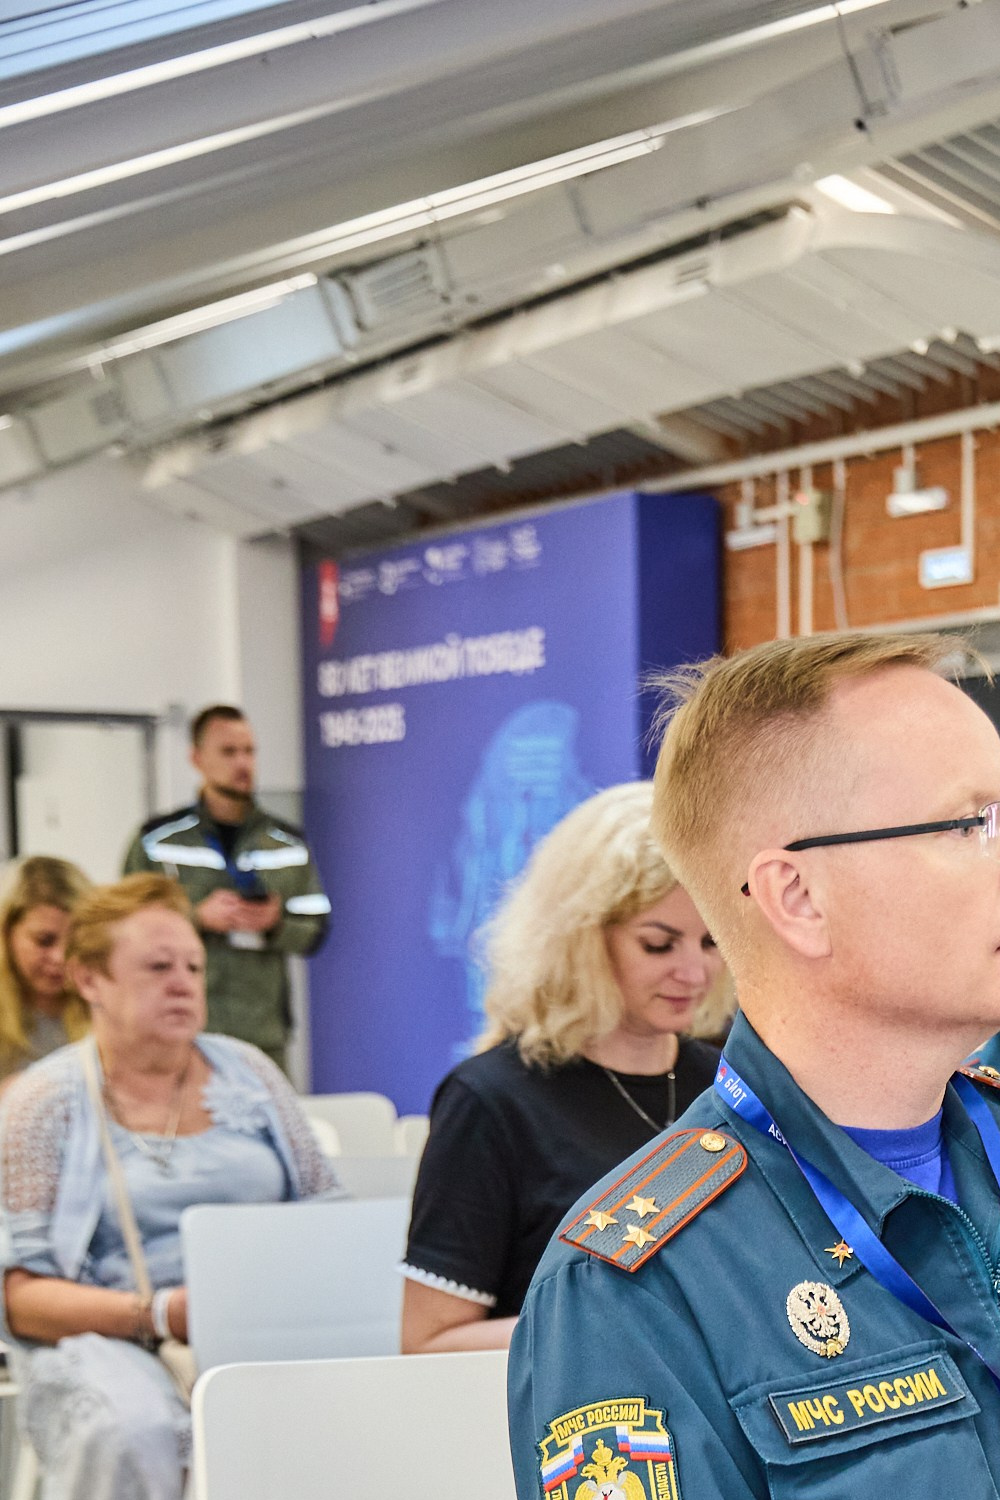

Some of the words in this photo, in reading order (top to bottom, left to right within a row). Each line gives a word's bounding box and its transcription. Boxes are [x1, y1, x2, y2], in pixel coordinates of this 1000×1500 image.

[557, 1415, 586, 1440] МЧС
[586, 1404, 639, 1427] РОССИИ
[788, 1395, 844, 1431] МЧС
[846, 1368, 947, 1417] РОССИИ
